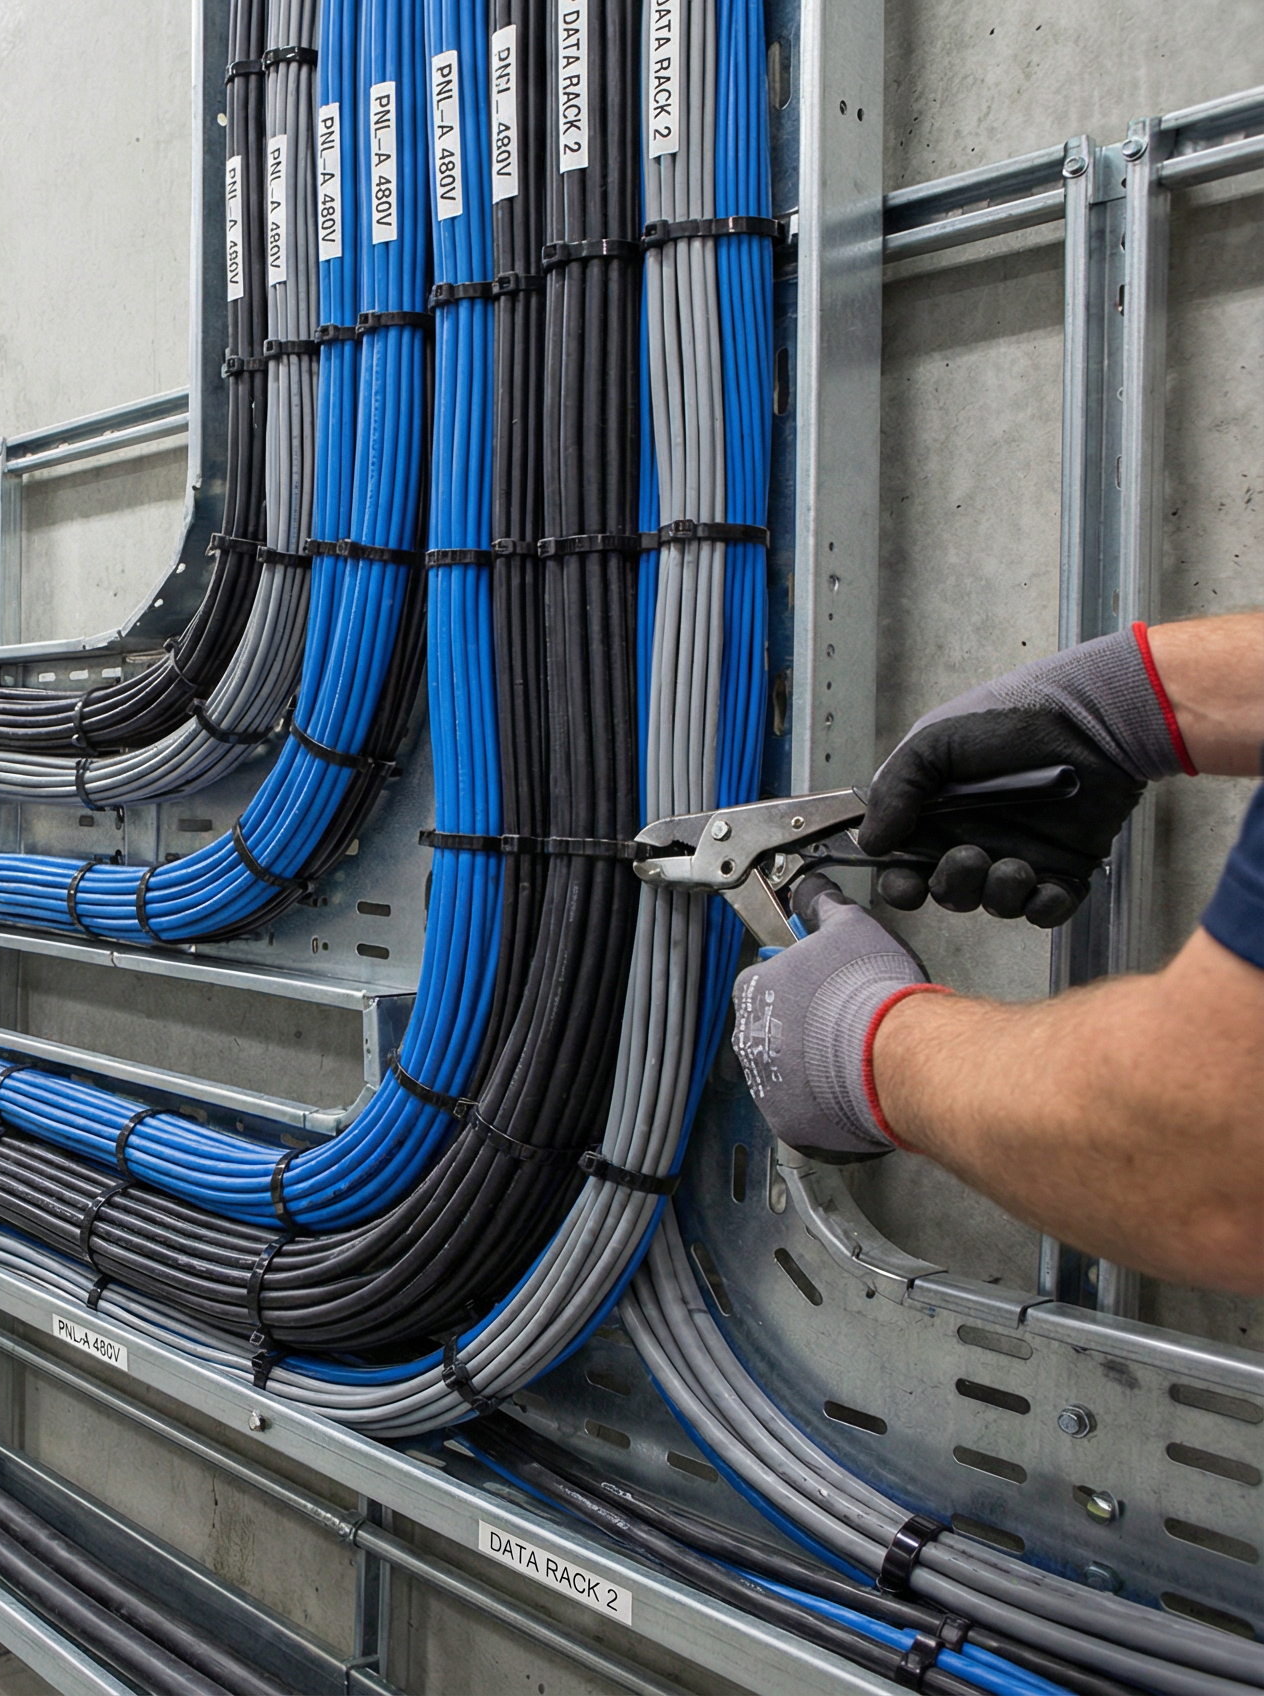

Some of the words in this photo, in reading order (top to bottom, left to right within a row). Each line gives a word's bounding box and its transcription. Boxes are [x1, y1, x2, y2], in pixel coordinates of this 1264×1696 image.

[562, 10, 581, 70] DATA
[436, 63, 455, 140] PNL-A
[562, 74, 582, 136] RACK
[653, 57, 672, 120] RACK
[320, 116, 336, 187] PNL-A
[373, 94, 392, 167] PNL-A
[495, 122, 512, 177] 480V
[563, 141, 582, 156] 2
[653, 126, 672, 141] 2
[375, 175, 393, 226] 480V
[439, 148, 456, 201] 480V
[269, 222, 281, 269] 480V
[320, 194, 336, 243] 480V
[490, 1531, 540, 1573] DATA
[546, 1557, 601, 1603] RACK
[606, 1588, 619, 1612] 2
